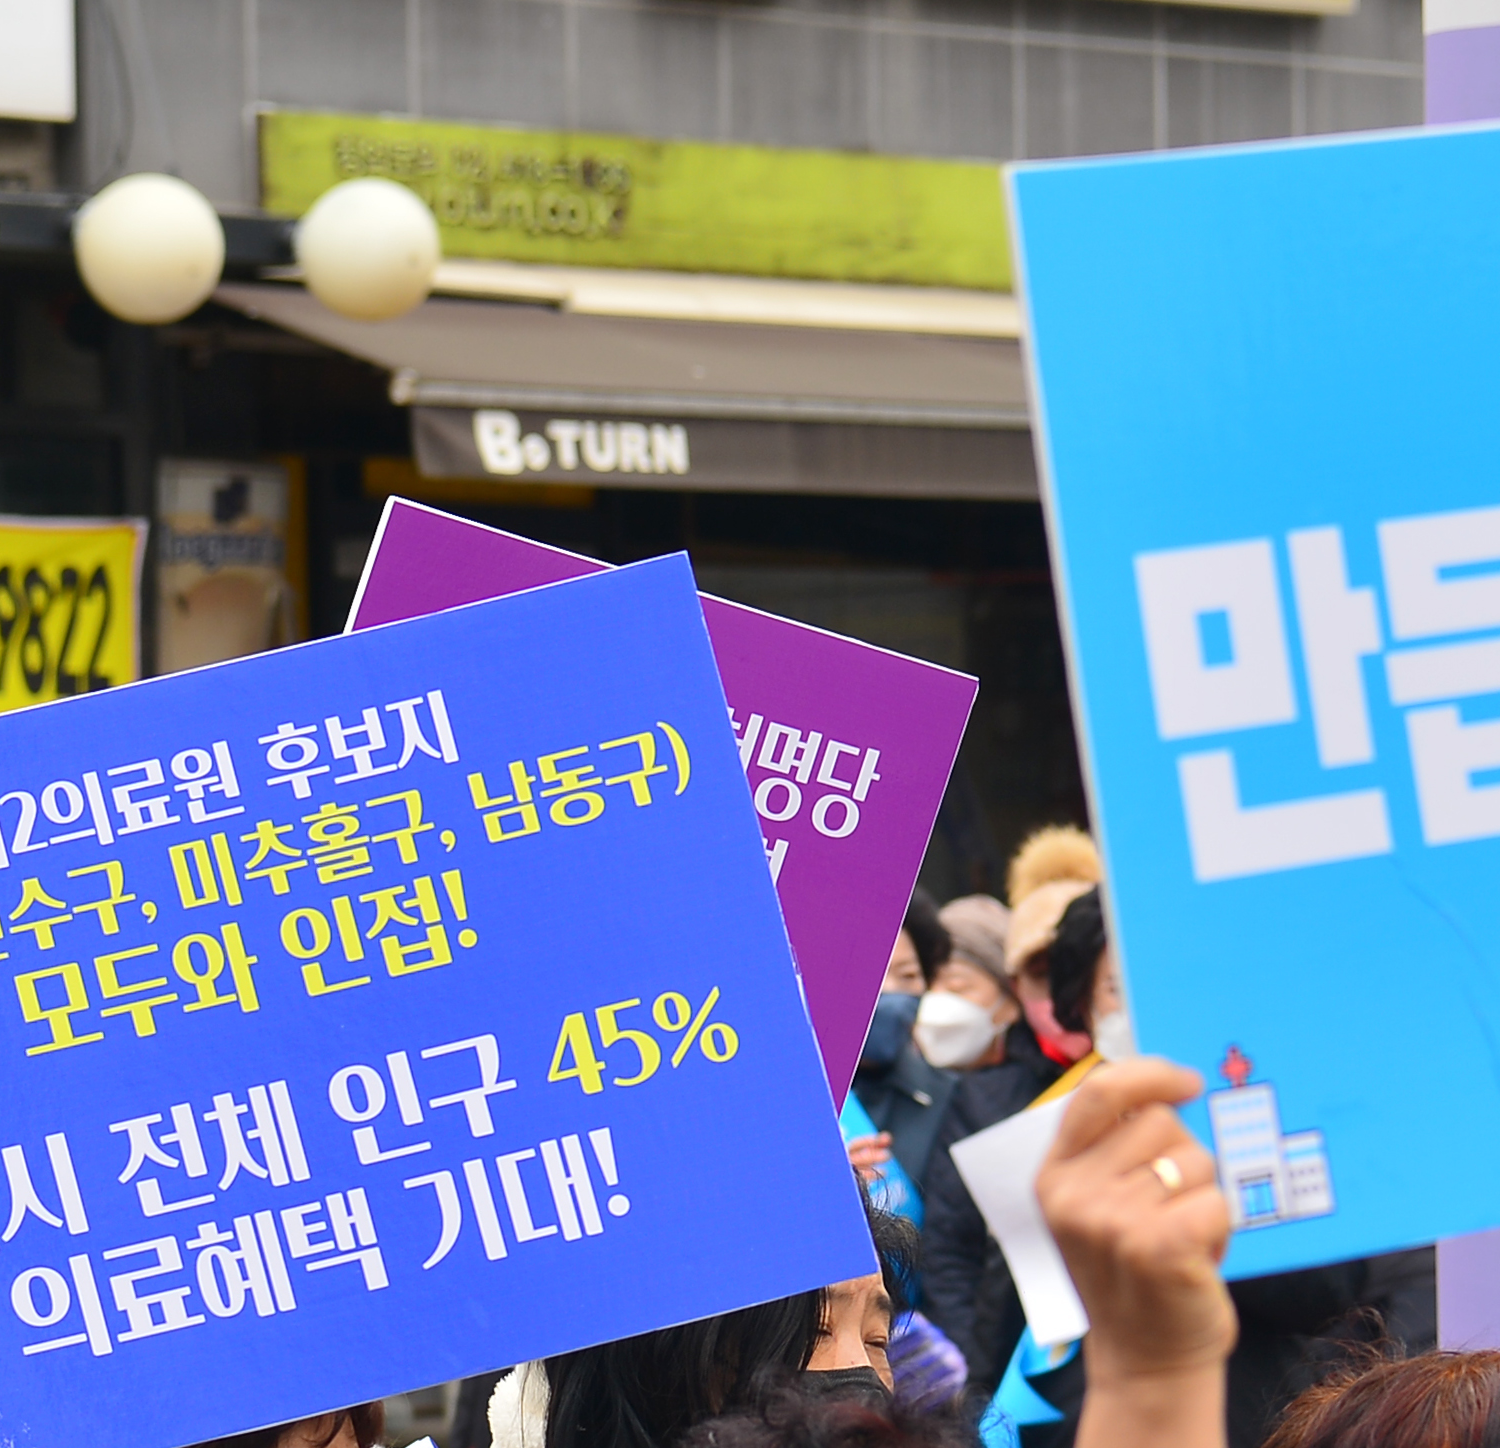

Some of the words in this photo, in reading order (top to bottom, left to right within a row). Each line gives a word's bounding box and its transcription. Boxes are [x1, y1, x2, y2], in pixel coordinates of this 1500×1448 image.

[169, 790, 458, 907] 미추홀구,
[467, 719, 694, 843] 남동구)
[257, 689, 462, 801] 후보지
[15, 937, 261, 1058] 모두와
[281, 870, 481, 998] 인접!
[116, 1078, 311, 1218] 전체
[328, 1034, 519, 1168] 인구
[546, 986, 740, 1097] 45%
[10, 1190, 392, 1358] 의료혜택
[417, 1125, 632, 1273] 기대!
